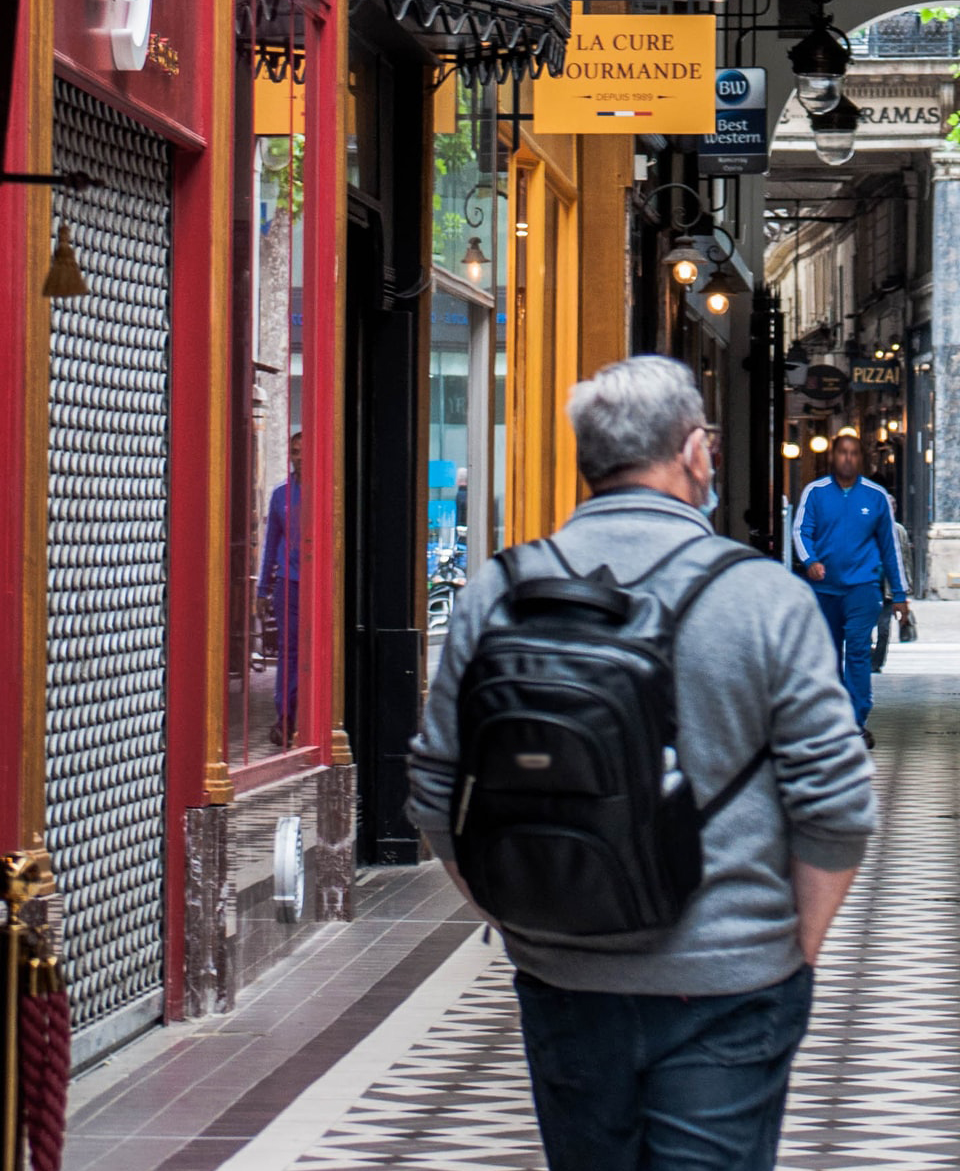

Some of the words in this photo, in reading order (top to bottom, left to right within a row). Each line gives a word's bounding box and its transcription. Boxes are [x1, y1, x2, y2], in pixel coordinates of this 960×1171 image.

[576, 34, 604, 51] LA
[613, 34, 674, 51] CURE
[558, 62, 702, 80] OURMANDE
[719, 80, 747, 96] BW
[595, 93, 631, 101] DEPUIS
[717, 119, 749, 131] Best
[704, 133, 761, 144] Western
